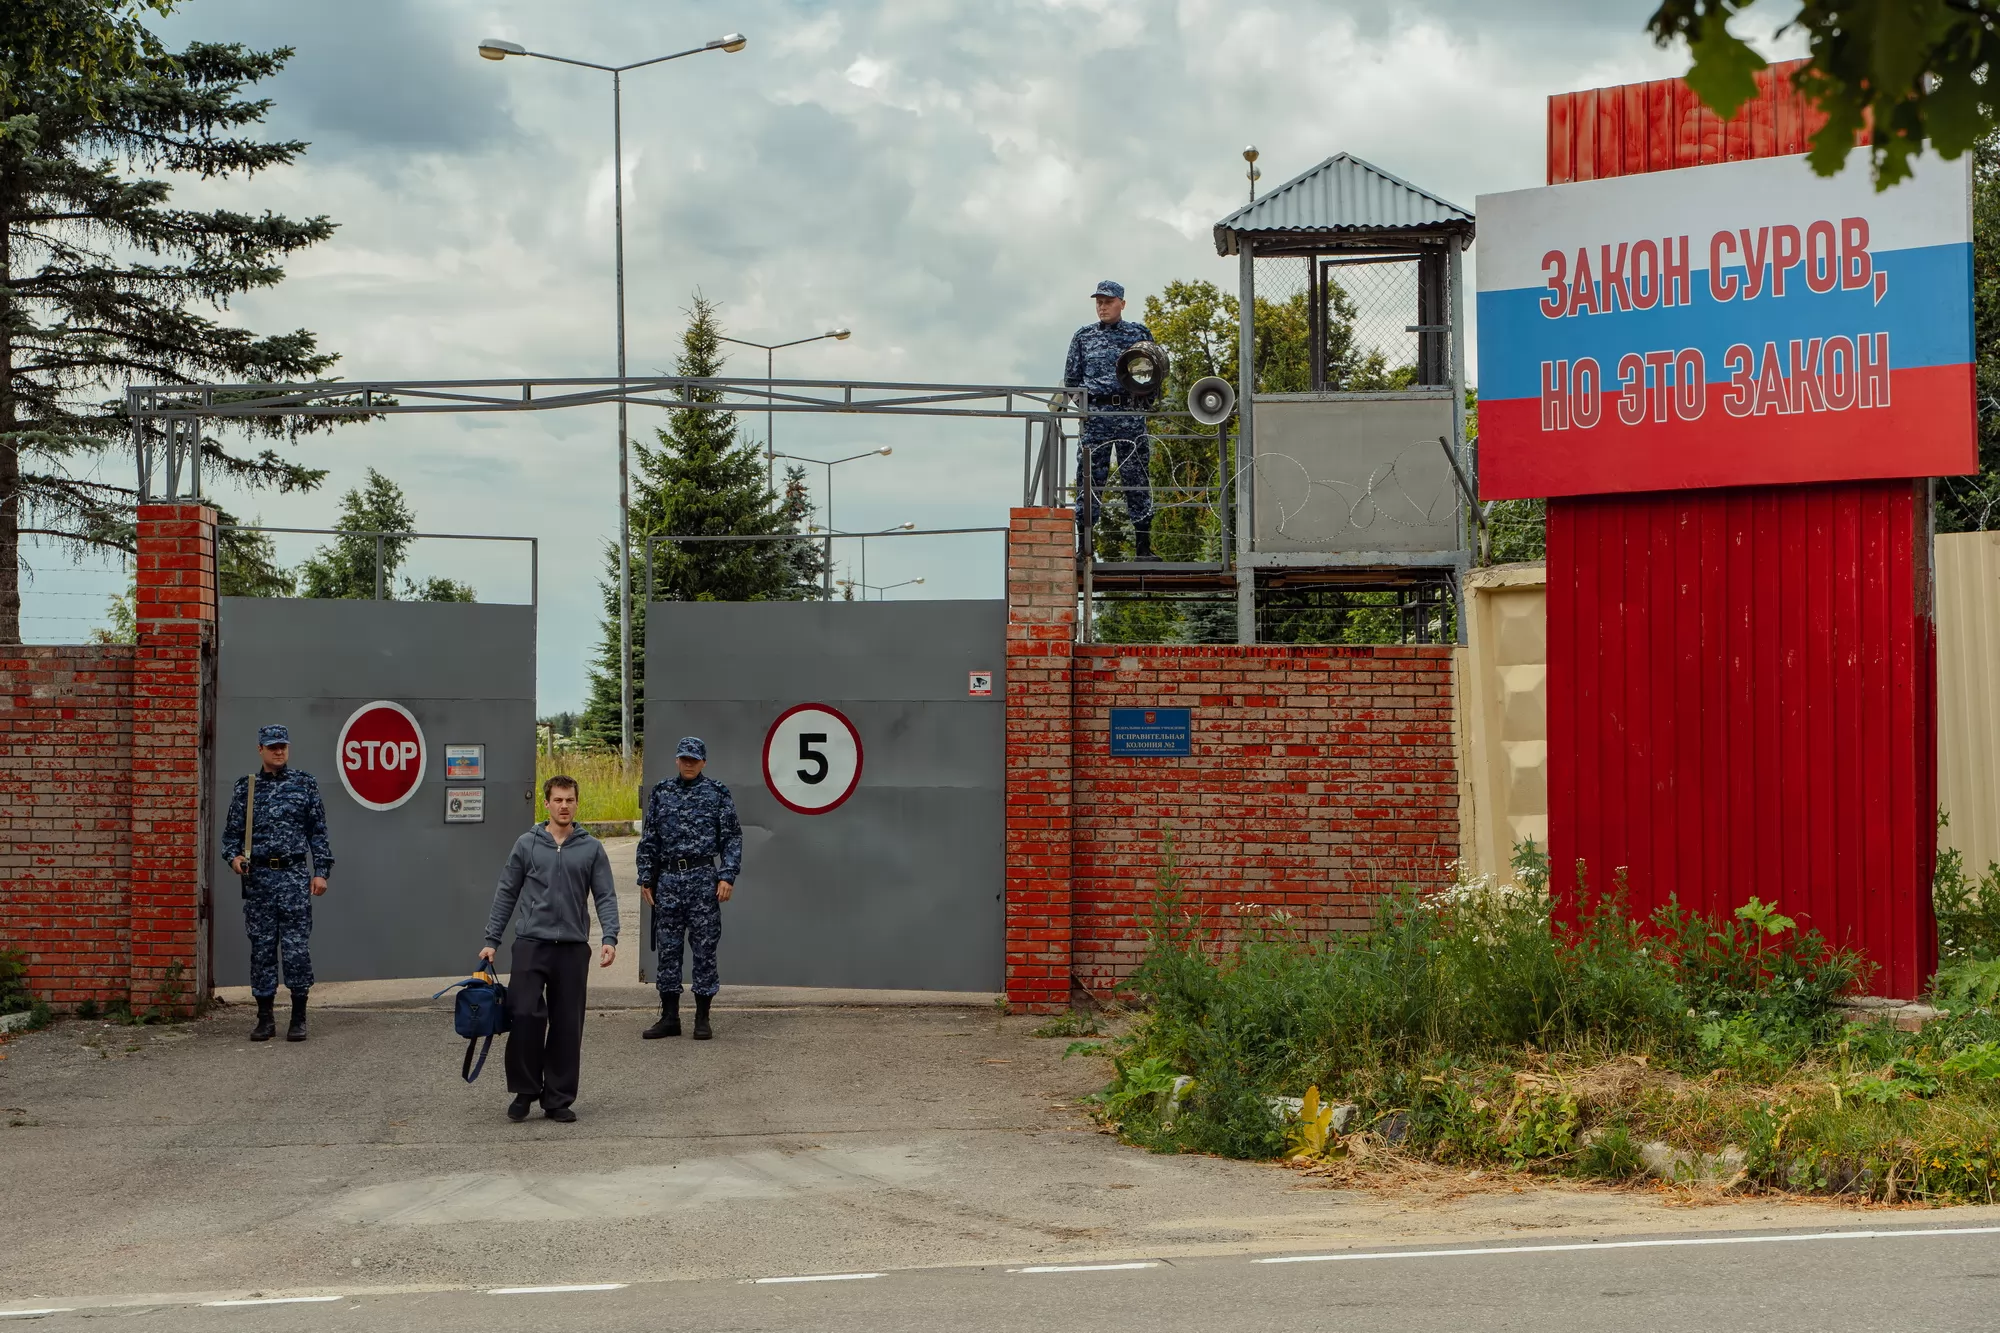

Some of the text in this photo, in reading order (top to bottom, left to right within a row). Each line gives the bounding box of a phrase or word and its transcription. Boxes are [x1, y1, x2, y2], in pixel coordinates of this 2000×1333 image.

[1540, 216, 1887, 319] ЗАКОН СУРОВ,
[1541, 331, 1891, 431] НО ЭТО ЗАКОН
[345, 740, 418, 770] STOP
[796, 733, 829, 785] 5
